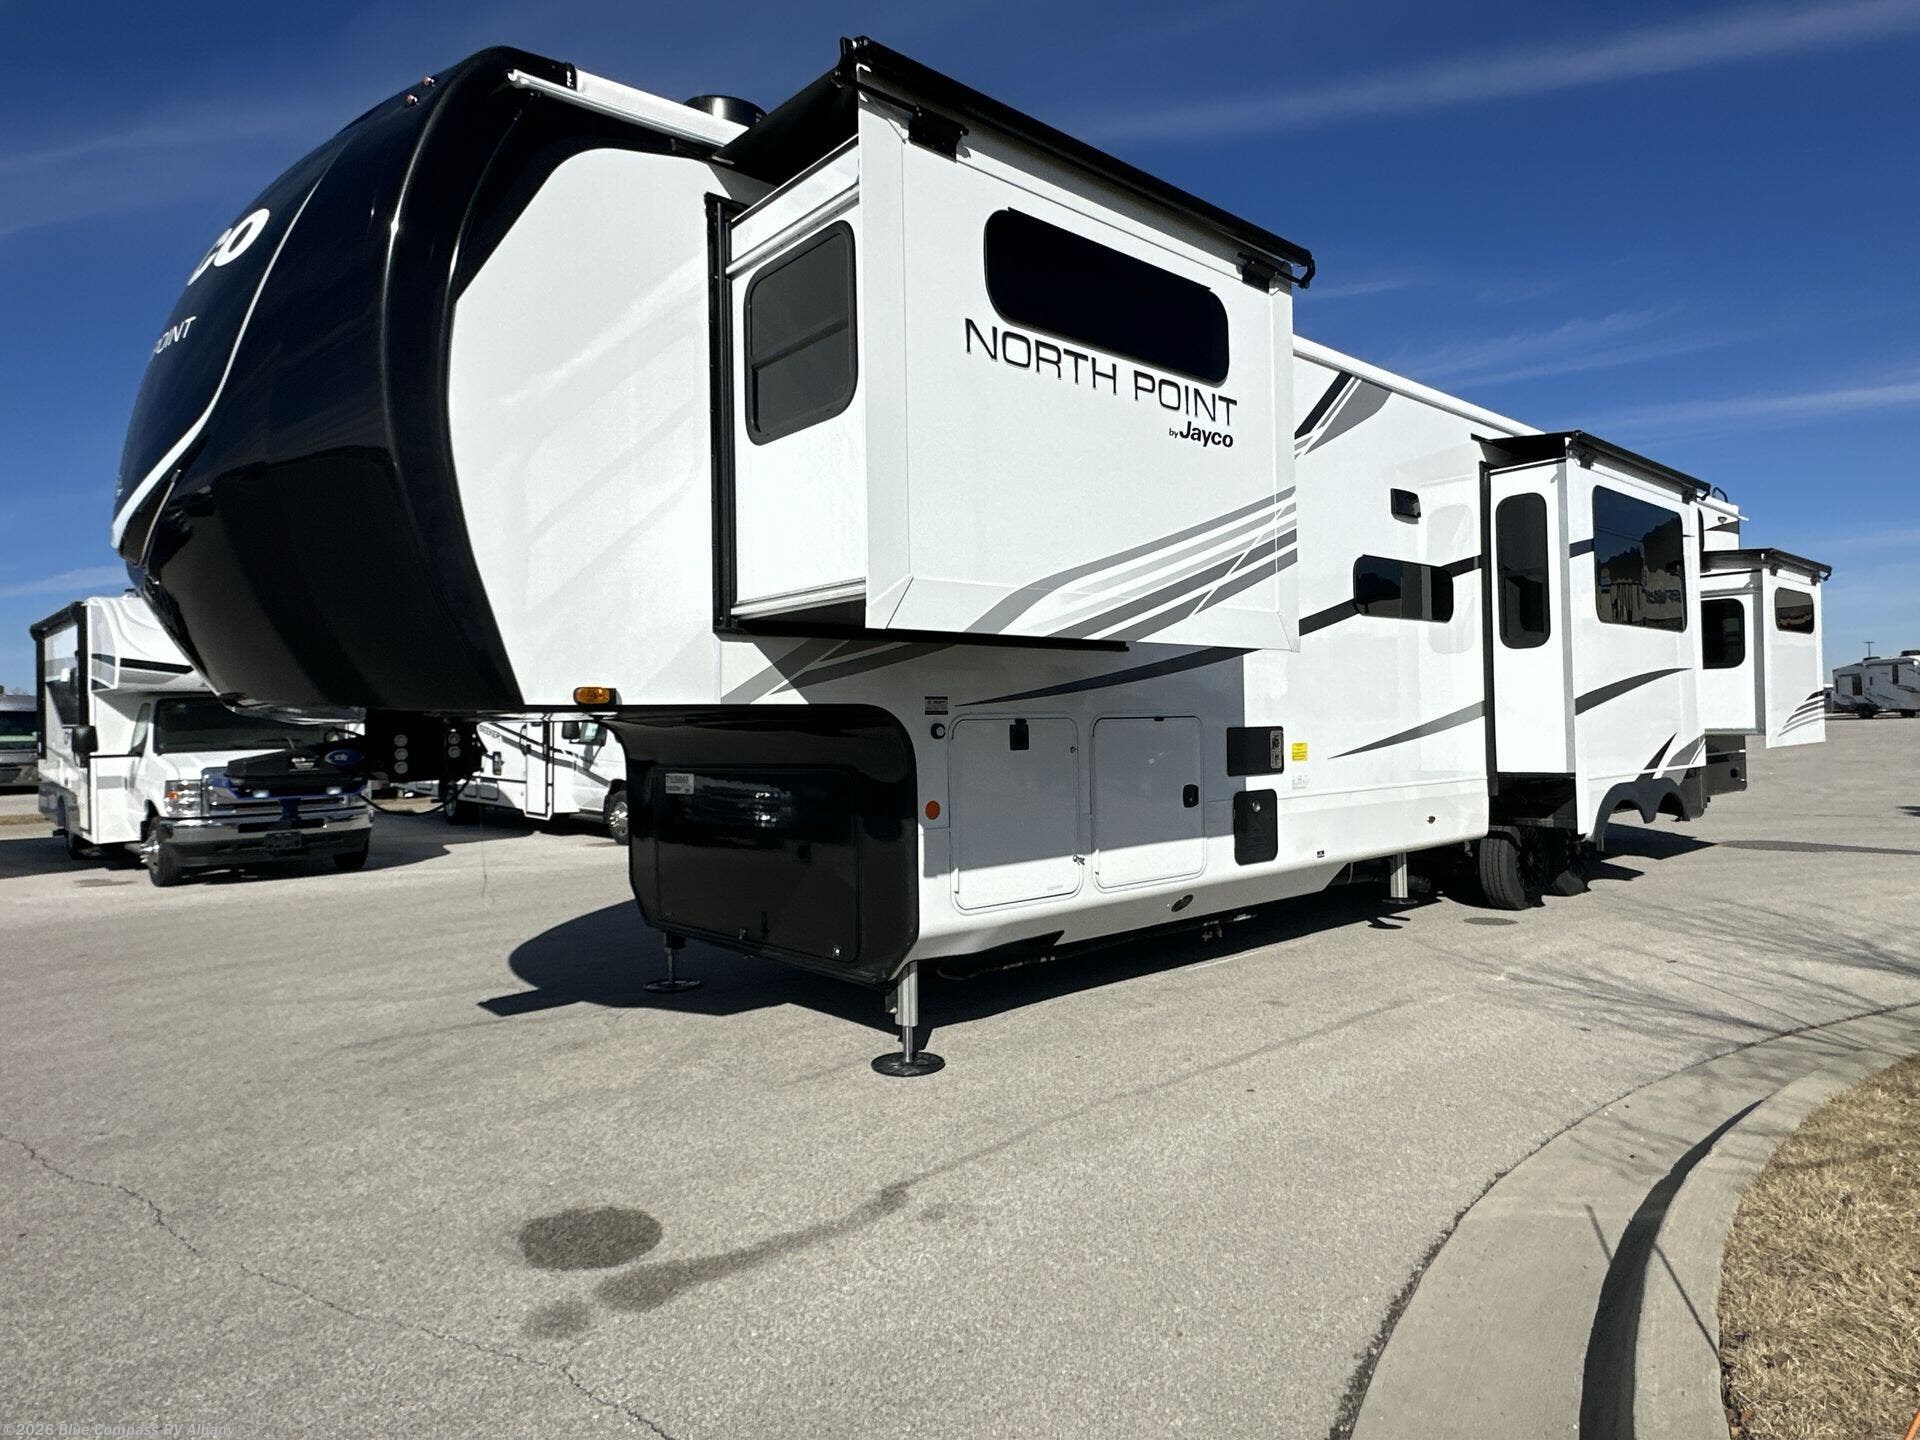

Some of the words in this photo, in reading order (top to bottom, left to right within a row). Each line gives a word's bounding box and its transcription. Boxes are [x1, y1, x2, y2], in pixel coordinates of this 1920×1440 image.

[965, 317, 1118, 396] NORTH
[1133, 369, 1238, 427] POINT
[1168, 427, 1179, 439] by
[1179, 420, 1234, 448] Jayco
